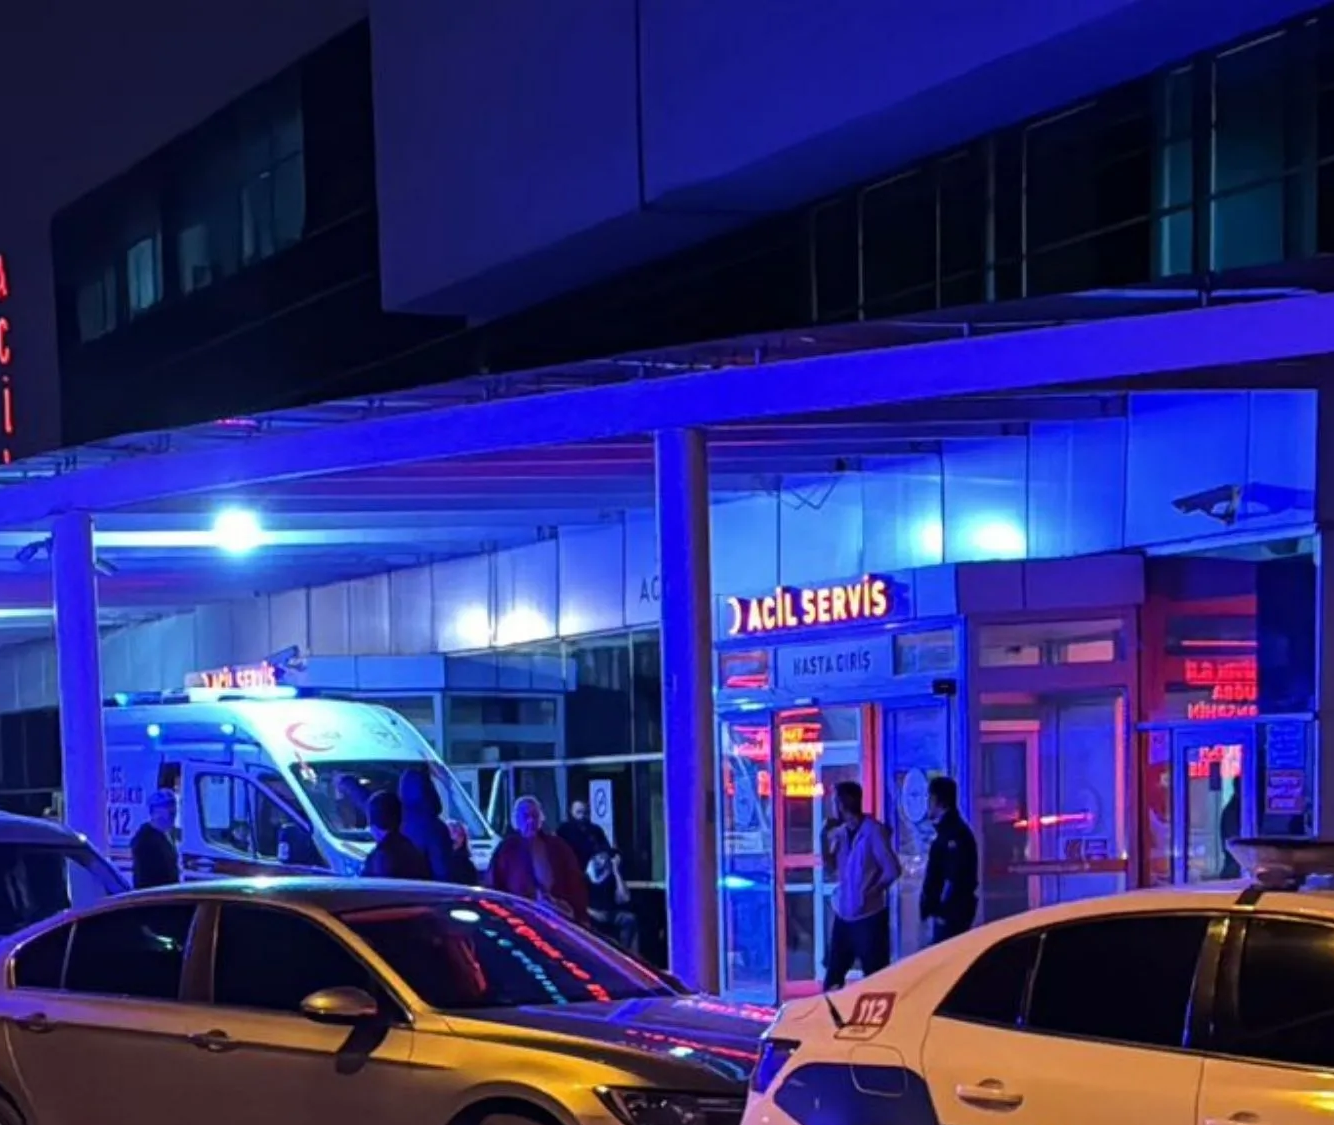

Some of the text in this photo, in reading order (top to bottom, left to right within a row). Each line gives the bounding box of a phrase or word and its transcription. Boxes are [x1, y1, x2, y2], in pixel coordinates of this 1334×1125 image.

[746, 573, 887, 632] ACİL SERVİS
[856, 999, 889, 1024] 112
